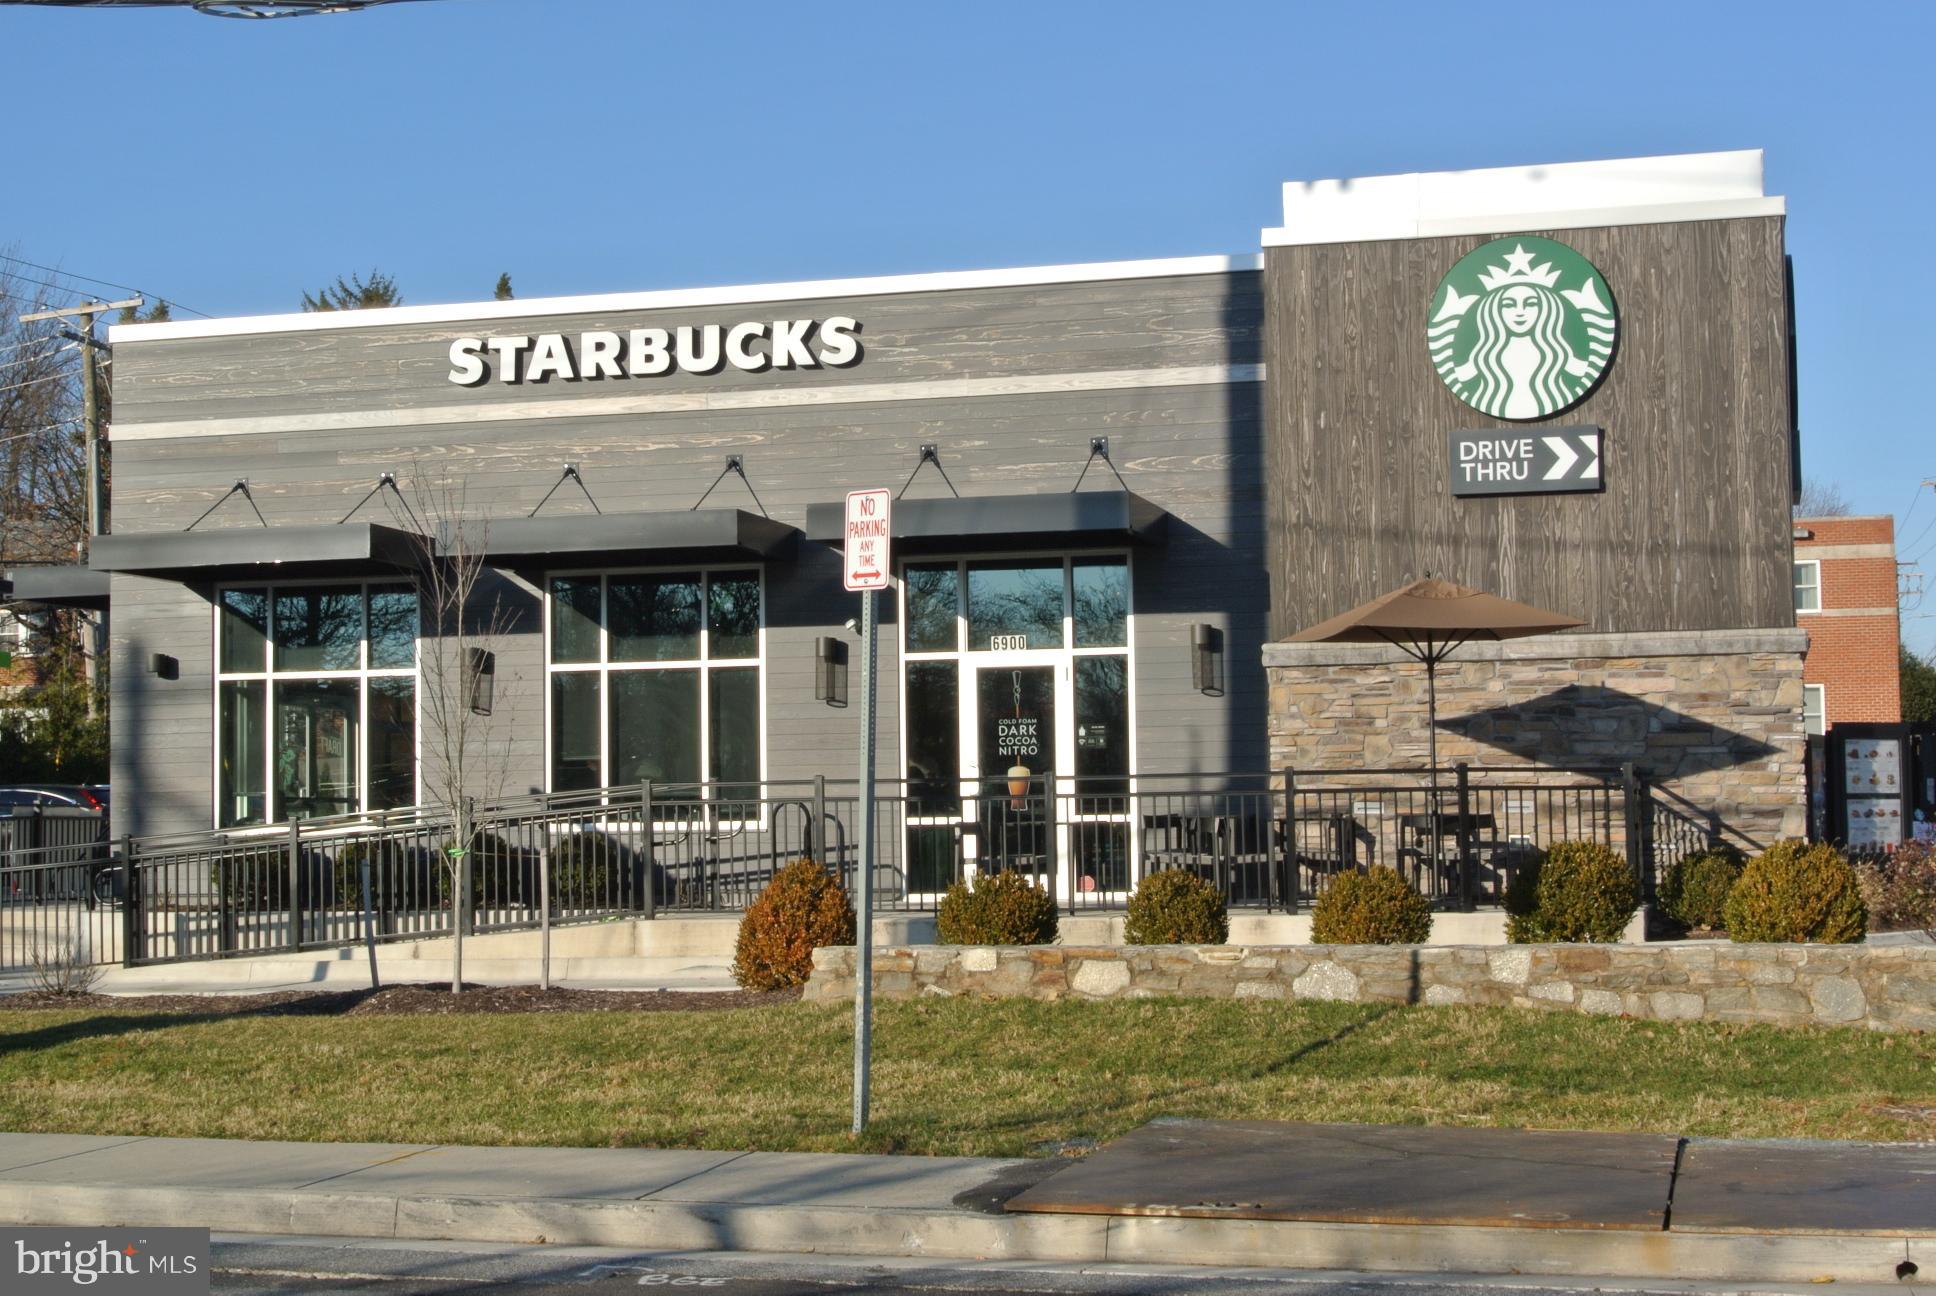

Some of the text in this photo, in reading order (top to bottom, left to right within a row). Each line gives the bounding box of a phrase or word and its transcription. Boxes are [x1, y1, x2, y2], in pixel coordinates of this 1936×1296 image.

[448, 316, 862, 387] STARBUCKS
[1459, 438, 1534, 461] DRIVE
[1460, 460, 1528, 482] THRU
[860, 498, 875, 516] NO
[849, 519, 886, 538] PARKING
[860, 540, 874, 552] ANY
[859, 554, 875, 566] TIME
[990, 636, 1025, 650] 6900
[998, 725, 1037, 736] DARK
[999, 736, 1037, 745] COCOA
[999, 745, 1038, 755] NITRO
